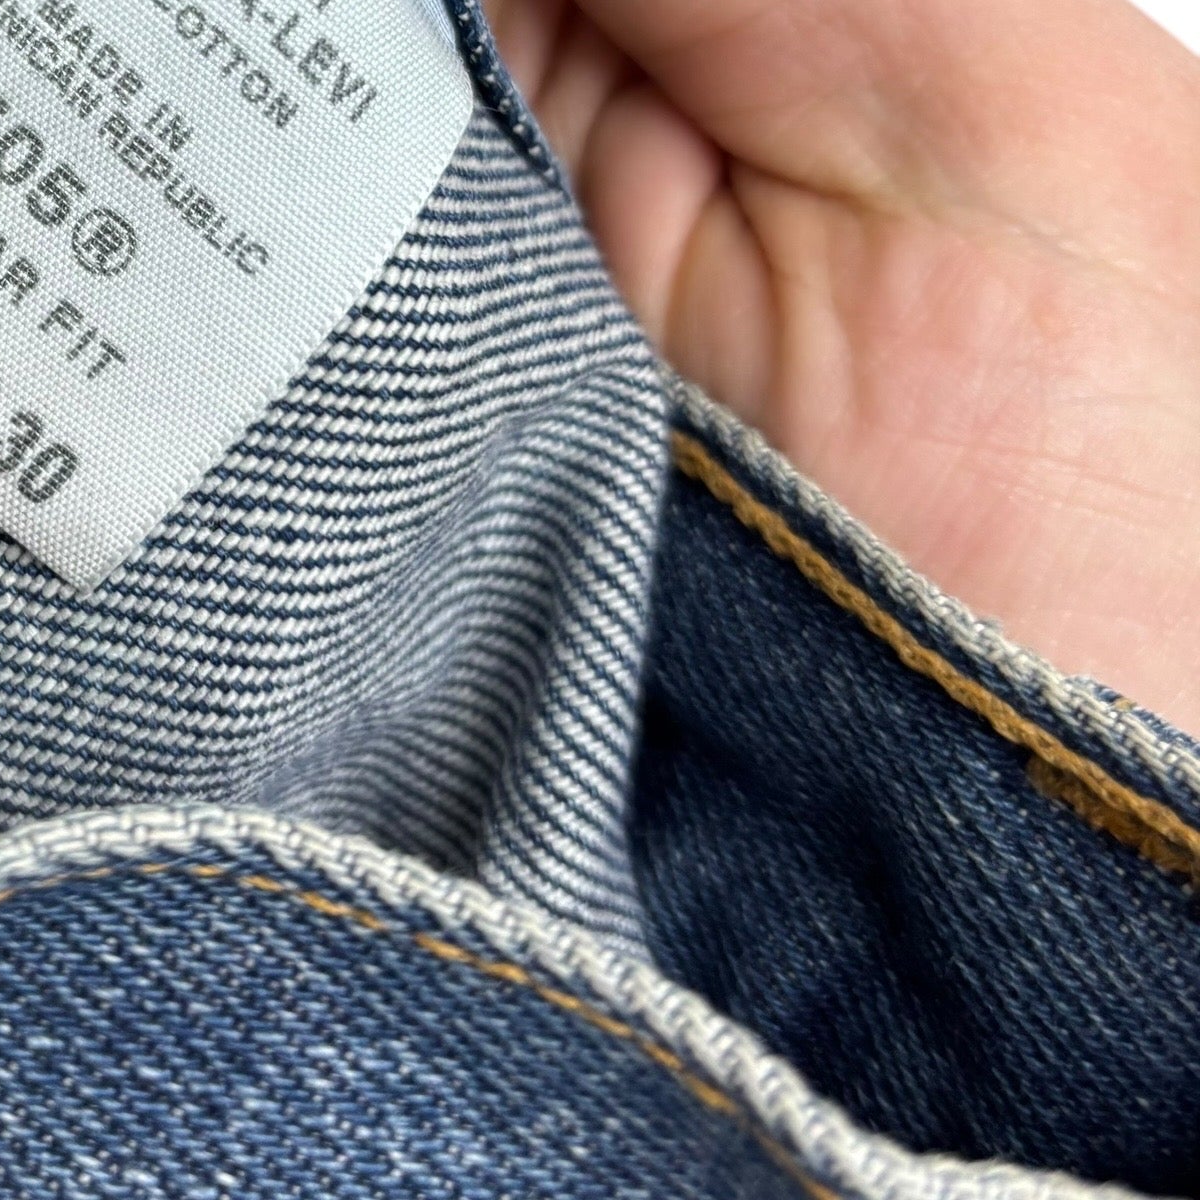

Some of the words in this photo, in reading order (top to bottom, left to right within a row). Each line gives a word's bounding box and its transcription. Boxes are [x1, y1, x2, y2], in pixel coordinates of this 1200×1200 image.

[146, 103, 194, 152] IN
[99, 110, 270, 275] REPUBLIC
[38, 298, 128, 380] FIT
